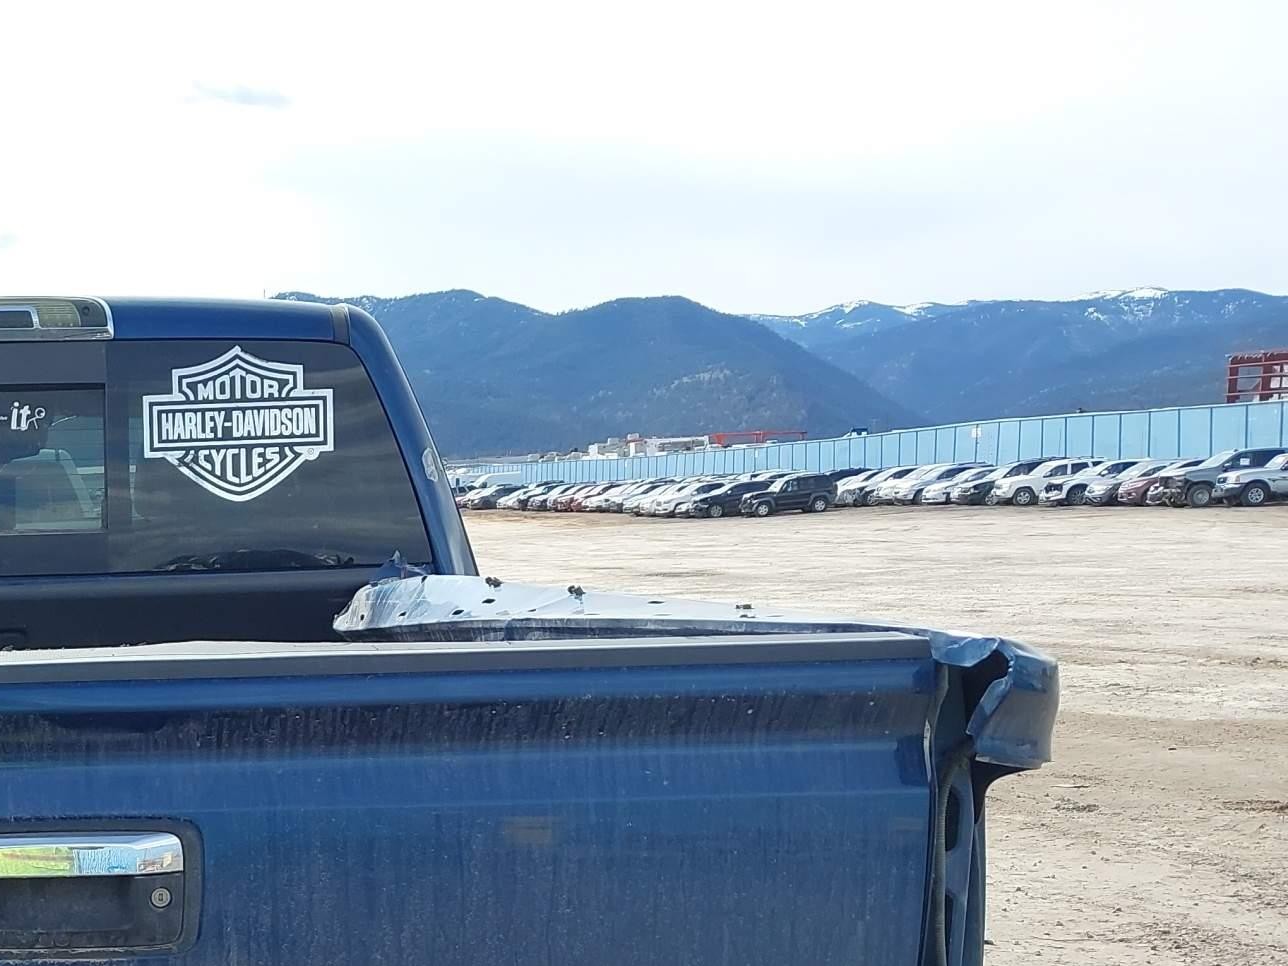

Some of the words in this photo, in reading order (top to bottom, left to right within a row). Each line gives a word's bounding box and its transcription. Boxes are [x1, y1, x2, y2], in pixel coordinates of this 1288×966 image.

[197, 367, 279, 401] MOTOR
[161, 407, 316, 441] HARLEY-DAVIDSON
[197, 446, 280, 484] CYCLES
